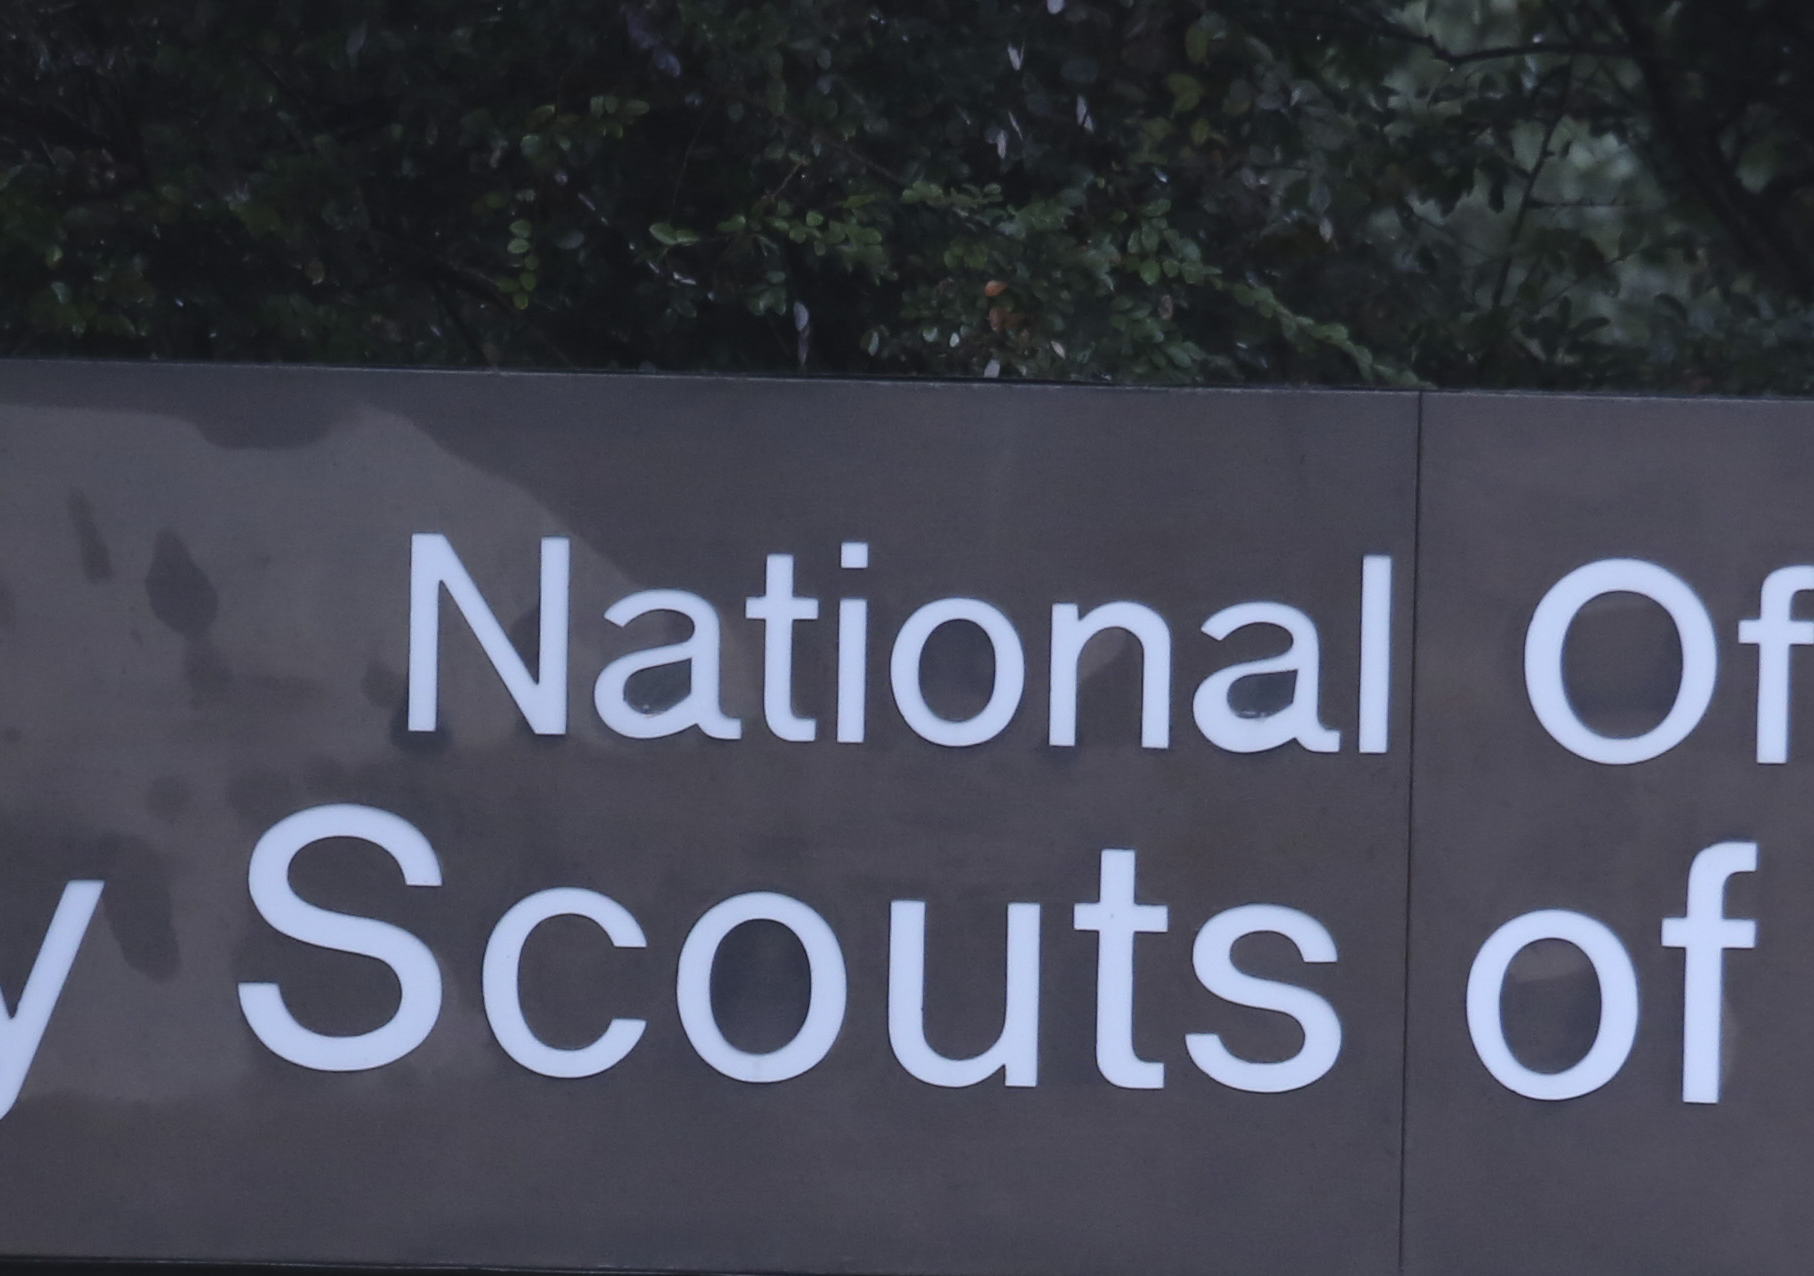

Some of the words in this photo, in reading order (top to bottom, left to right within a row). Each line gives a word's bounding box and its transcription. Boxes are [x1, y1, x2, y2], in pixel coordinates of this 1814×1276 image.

[405, 531, 1394, 756] National
[236, 801, 1345, 1096] Scouts
[1464, 838, 1760, 1107] of
